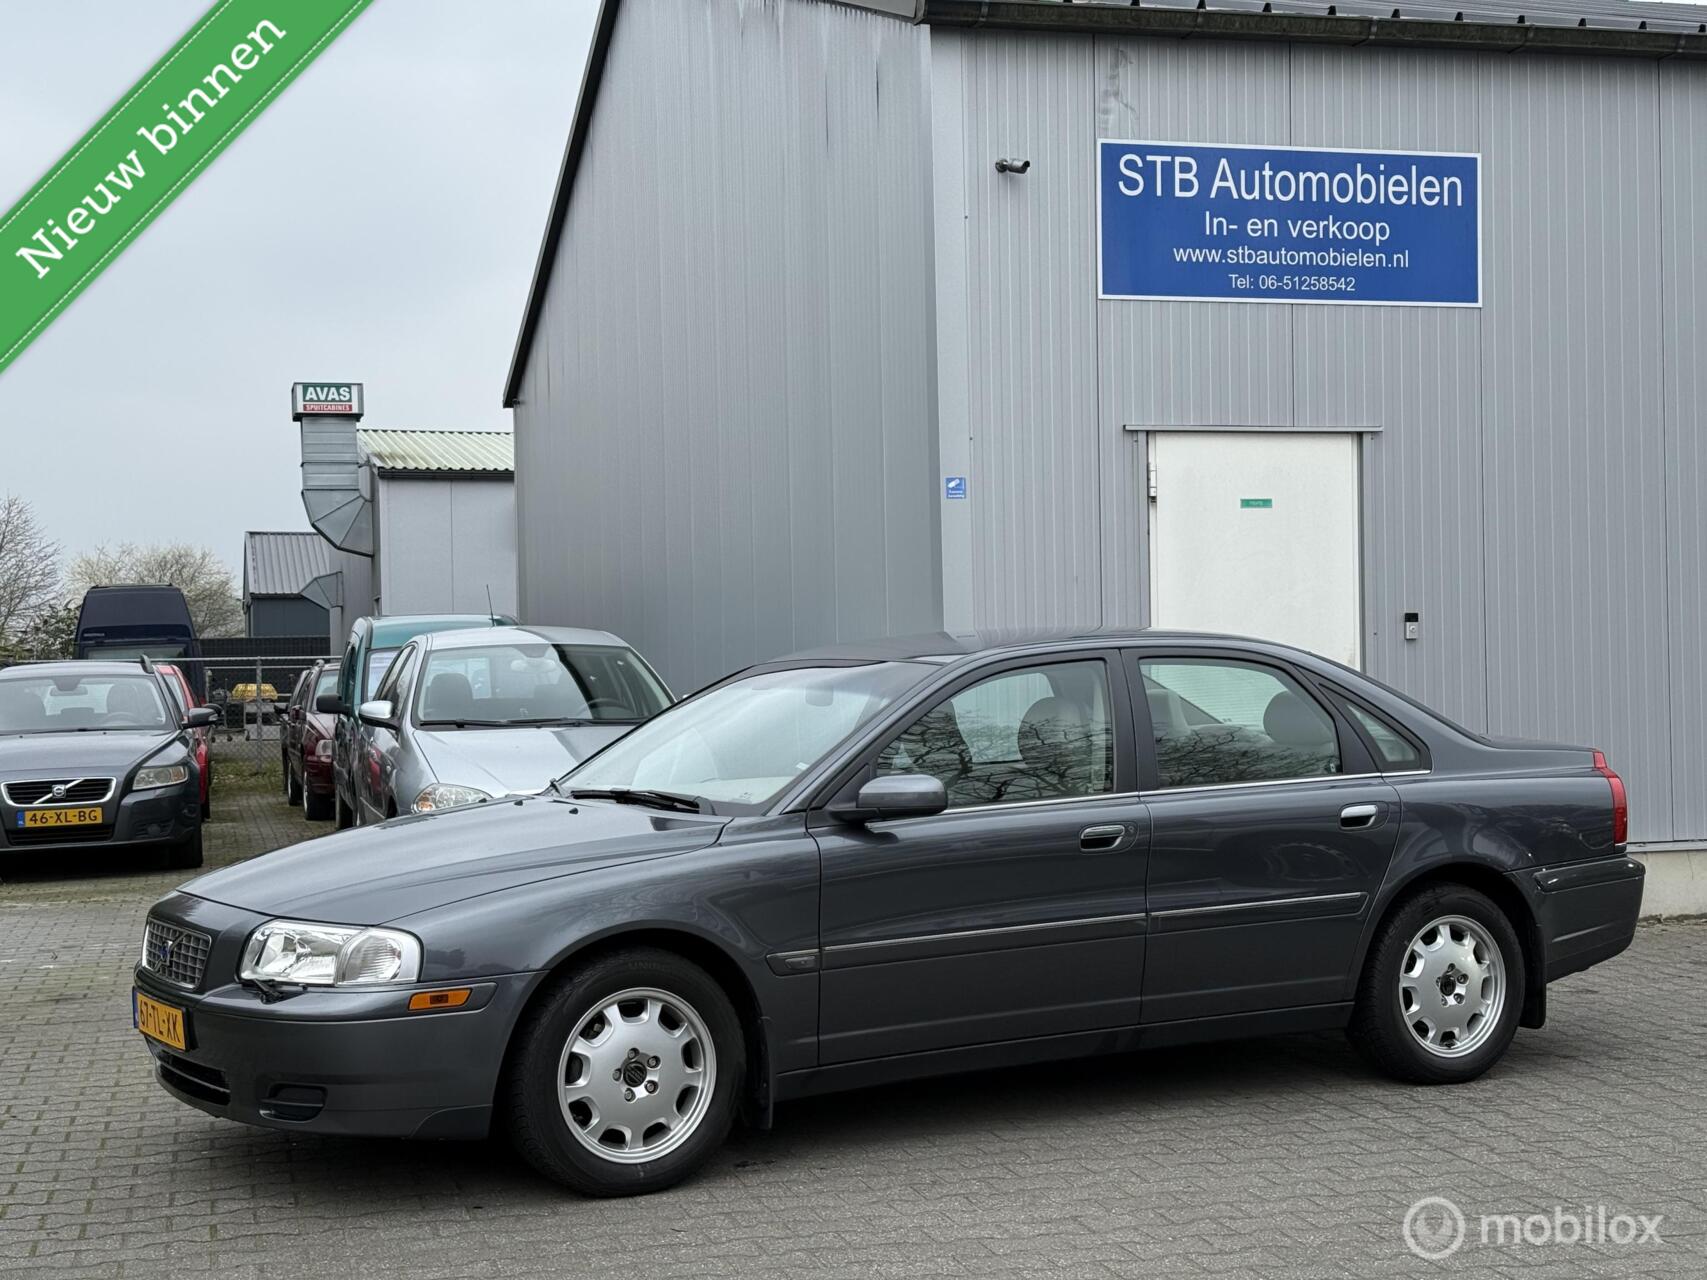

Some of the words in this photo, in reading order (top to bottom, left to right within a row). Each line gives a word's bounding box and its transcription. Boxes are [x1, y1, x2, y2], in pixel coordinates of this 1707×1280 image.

[1118, 153, 1199, 198] STB
[1210, 157, 1463, 207] Automobielen
[1204, 211, 1238, 236] In-
[1247, 217, 1278, 237] en
[1288, 216, 1390, 246] verkoop
[1174, 246, 1409, 268] www.stbautomobielen.nl
[1229, 274, 1254, 290] Tel:
[1259, 275, 1356, 292] 06-51258542
[305, 387, 350, 401] AVAS
[29, 809, 98, 825] 46-XL-BG
[139, 999, 181, 1043] 67-TL-XK
